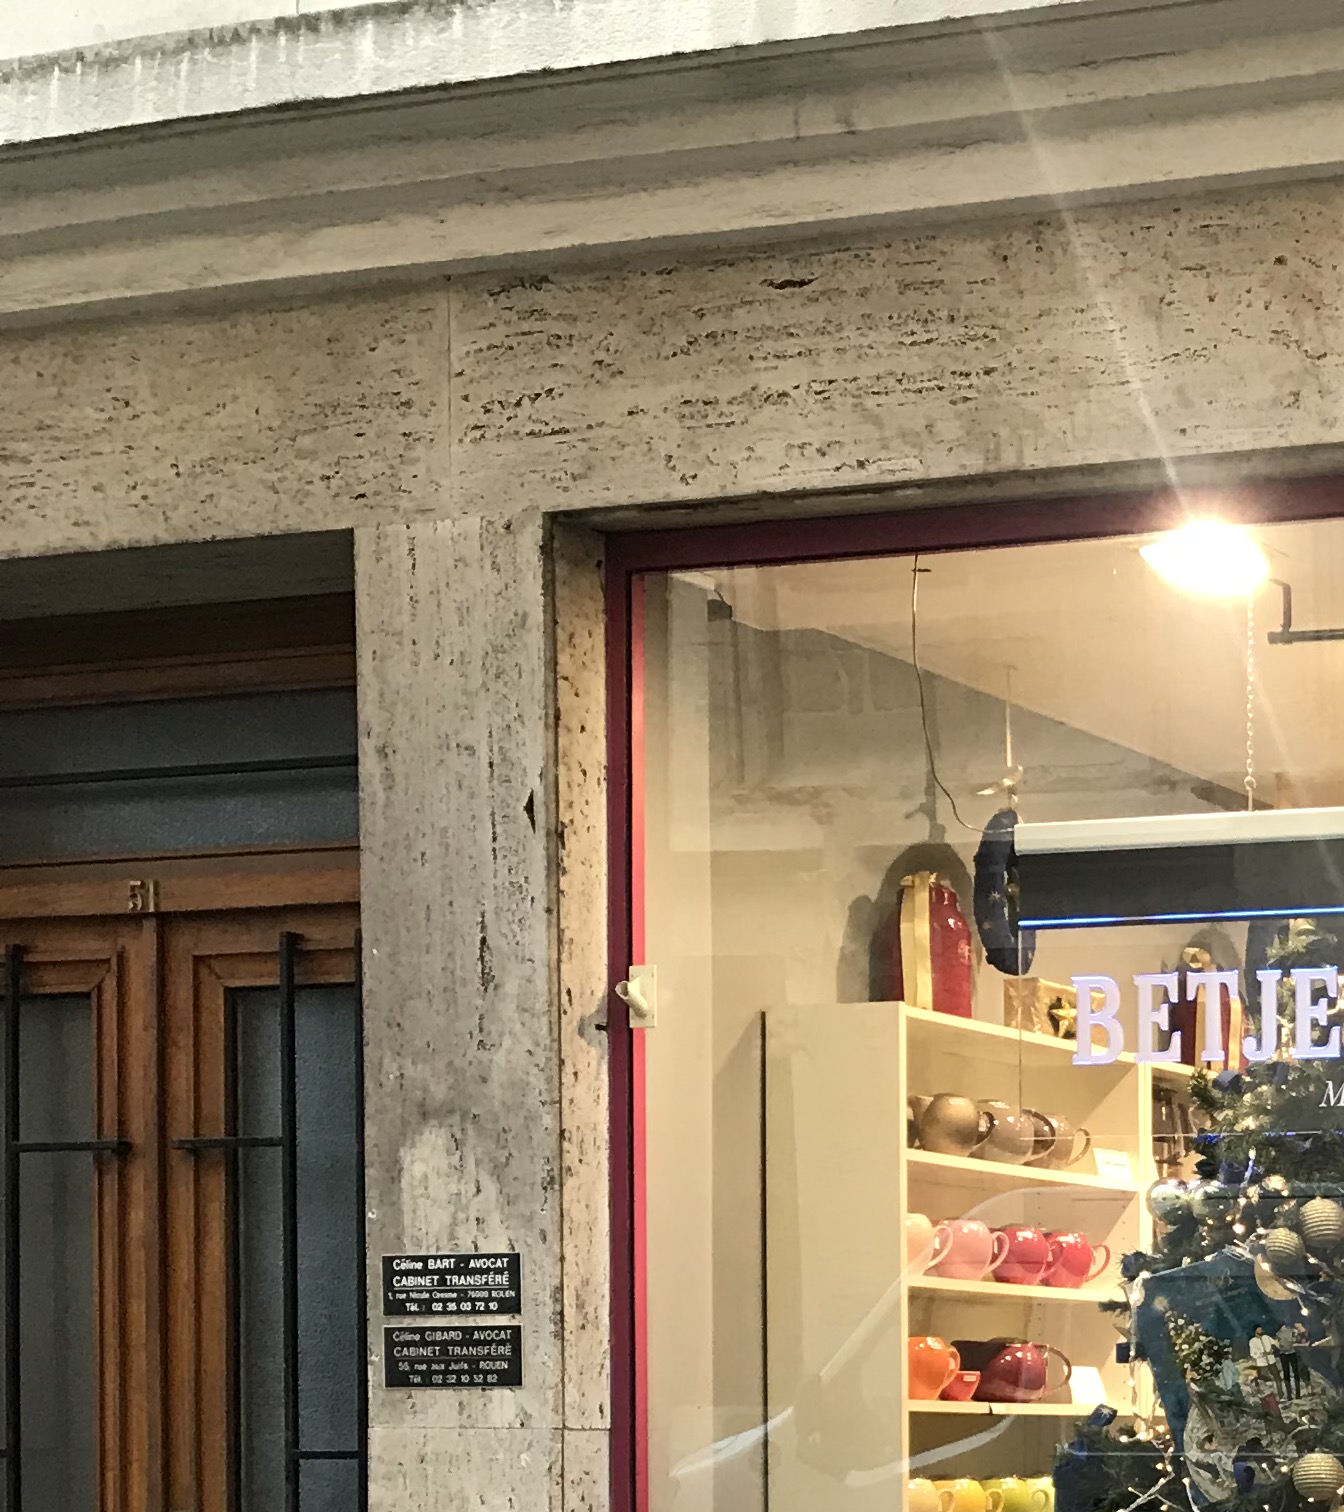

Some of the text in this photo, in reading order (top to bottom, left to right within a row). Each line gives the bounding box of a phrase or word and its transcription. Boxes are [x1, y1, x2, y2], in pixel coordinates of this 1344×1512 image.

[128, 880, 155, 913] 51
[392, 1258, 423, 1271] Céline
[427, 1258, 455, 1269] BART
[468, 1257, 509, 1269] AVOCAT
[392, 1271, 510, 1287] CABINET TRANSFÉRÉ
[431, 1302, 443, 1311] 02
[474, 1301, 485, 1311] 72
[488, 1301, 499, 1311] 10
[424, 1330, 462, 1341] GIBARD
[473, 1329, 512, 1341] AVOCAT
[393, 1342, 513, 1357] CABINET TRANSFÉRÉ
[479, 1360, 509, 1370] ROUEN
